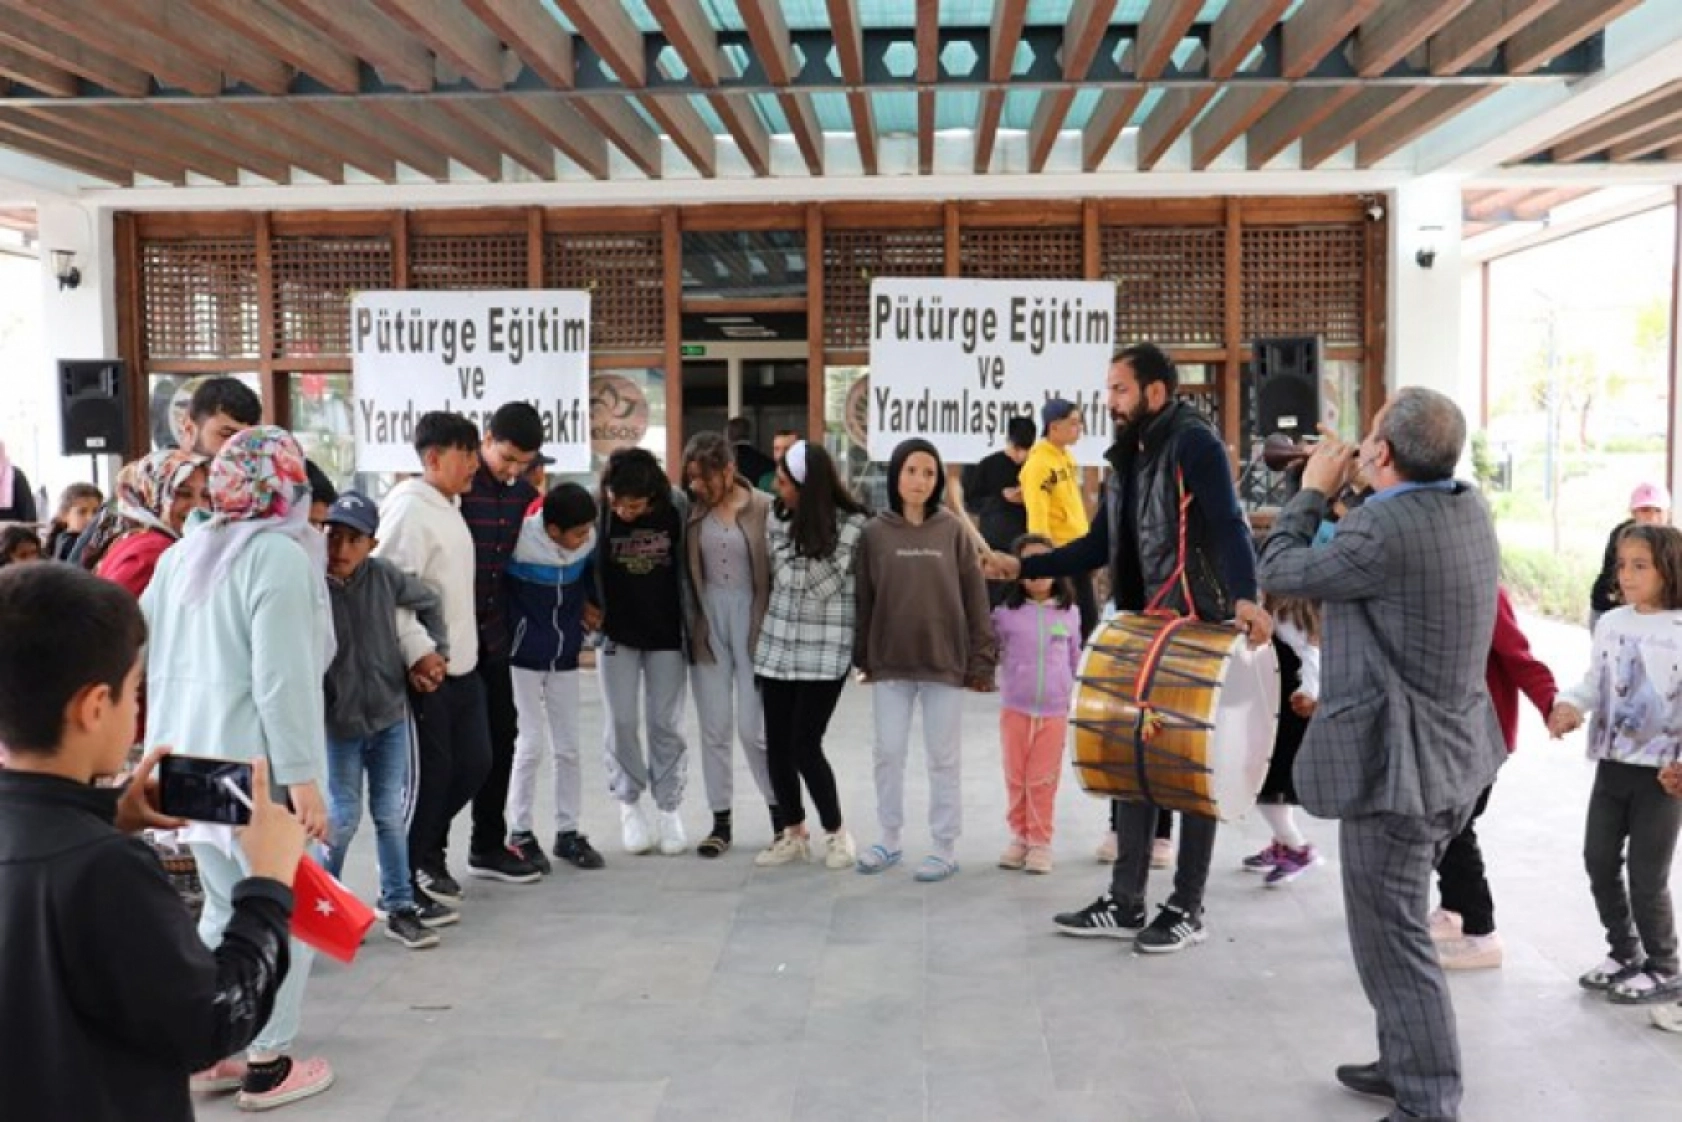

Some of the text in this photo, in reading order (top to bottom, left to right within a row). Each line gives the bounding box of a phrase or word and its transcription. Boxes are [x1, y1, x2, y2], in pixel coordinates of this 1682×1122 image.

[357, 307, 585, 365] Pütürge Eğitim
[876, 295, 1110, 355] Pütürge Eğitim
[457, 366, 486, 400] ve
[978, 355, 1006, 390] ve
